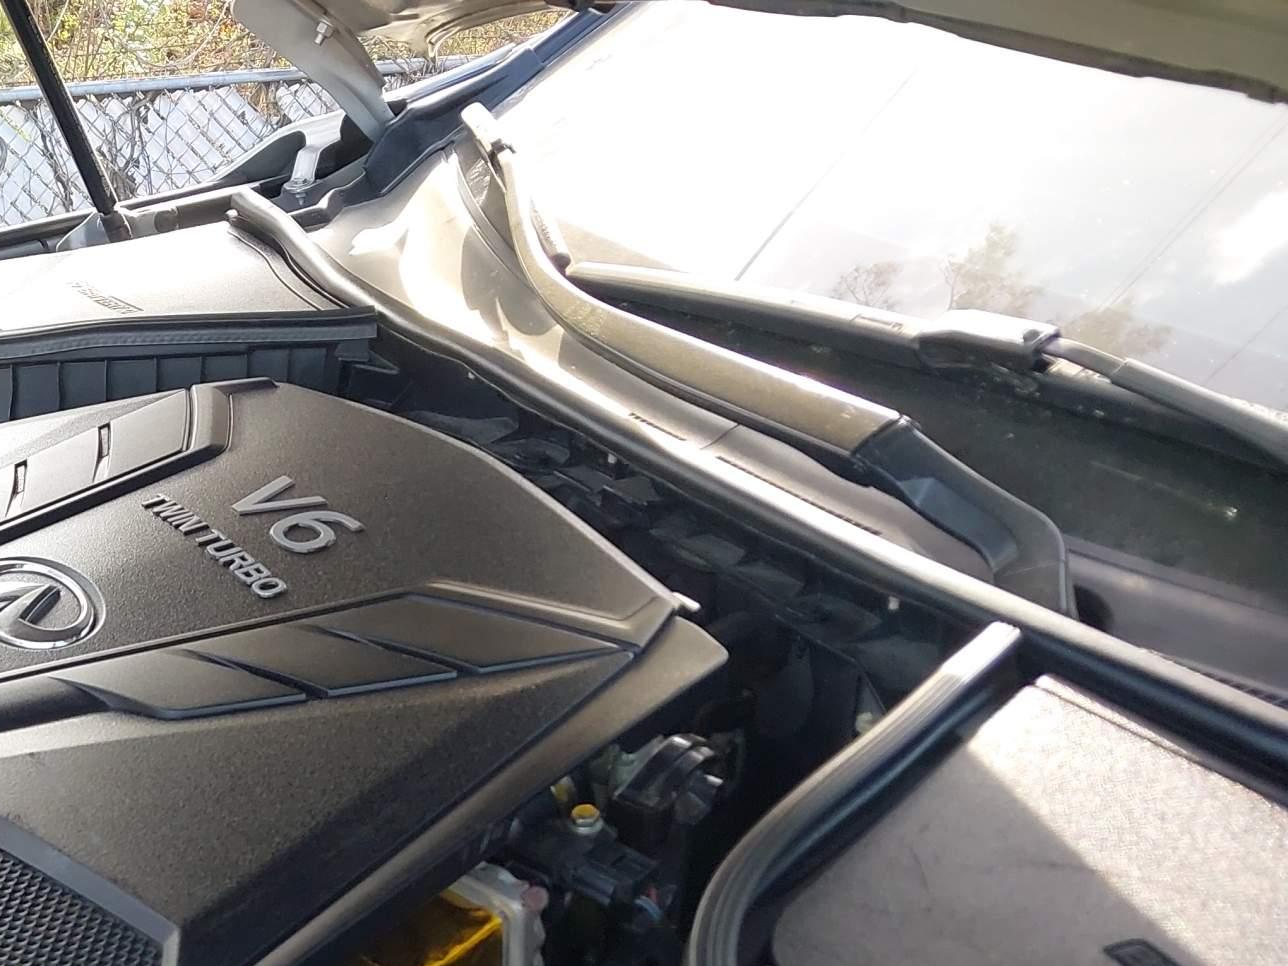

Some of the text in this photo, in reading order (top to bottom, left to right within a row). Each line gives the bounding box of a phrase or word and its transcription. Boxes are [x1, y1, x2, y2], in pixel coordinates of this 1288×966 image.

[141, 493, 288, 599] TWIN TURBO
[231, 475, 365, 553] V6
